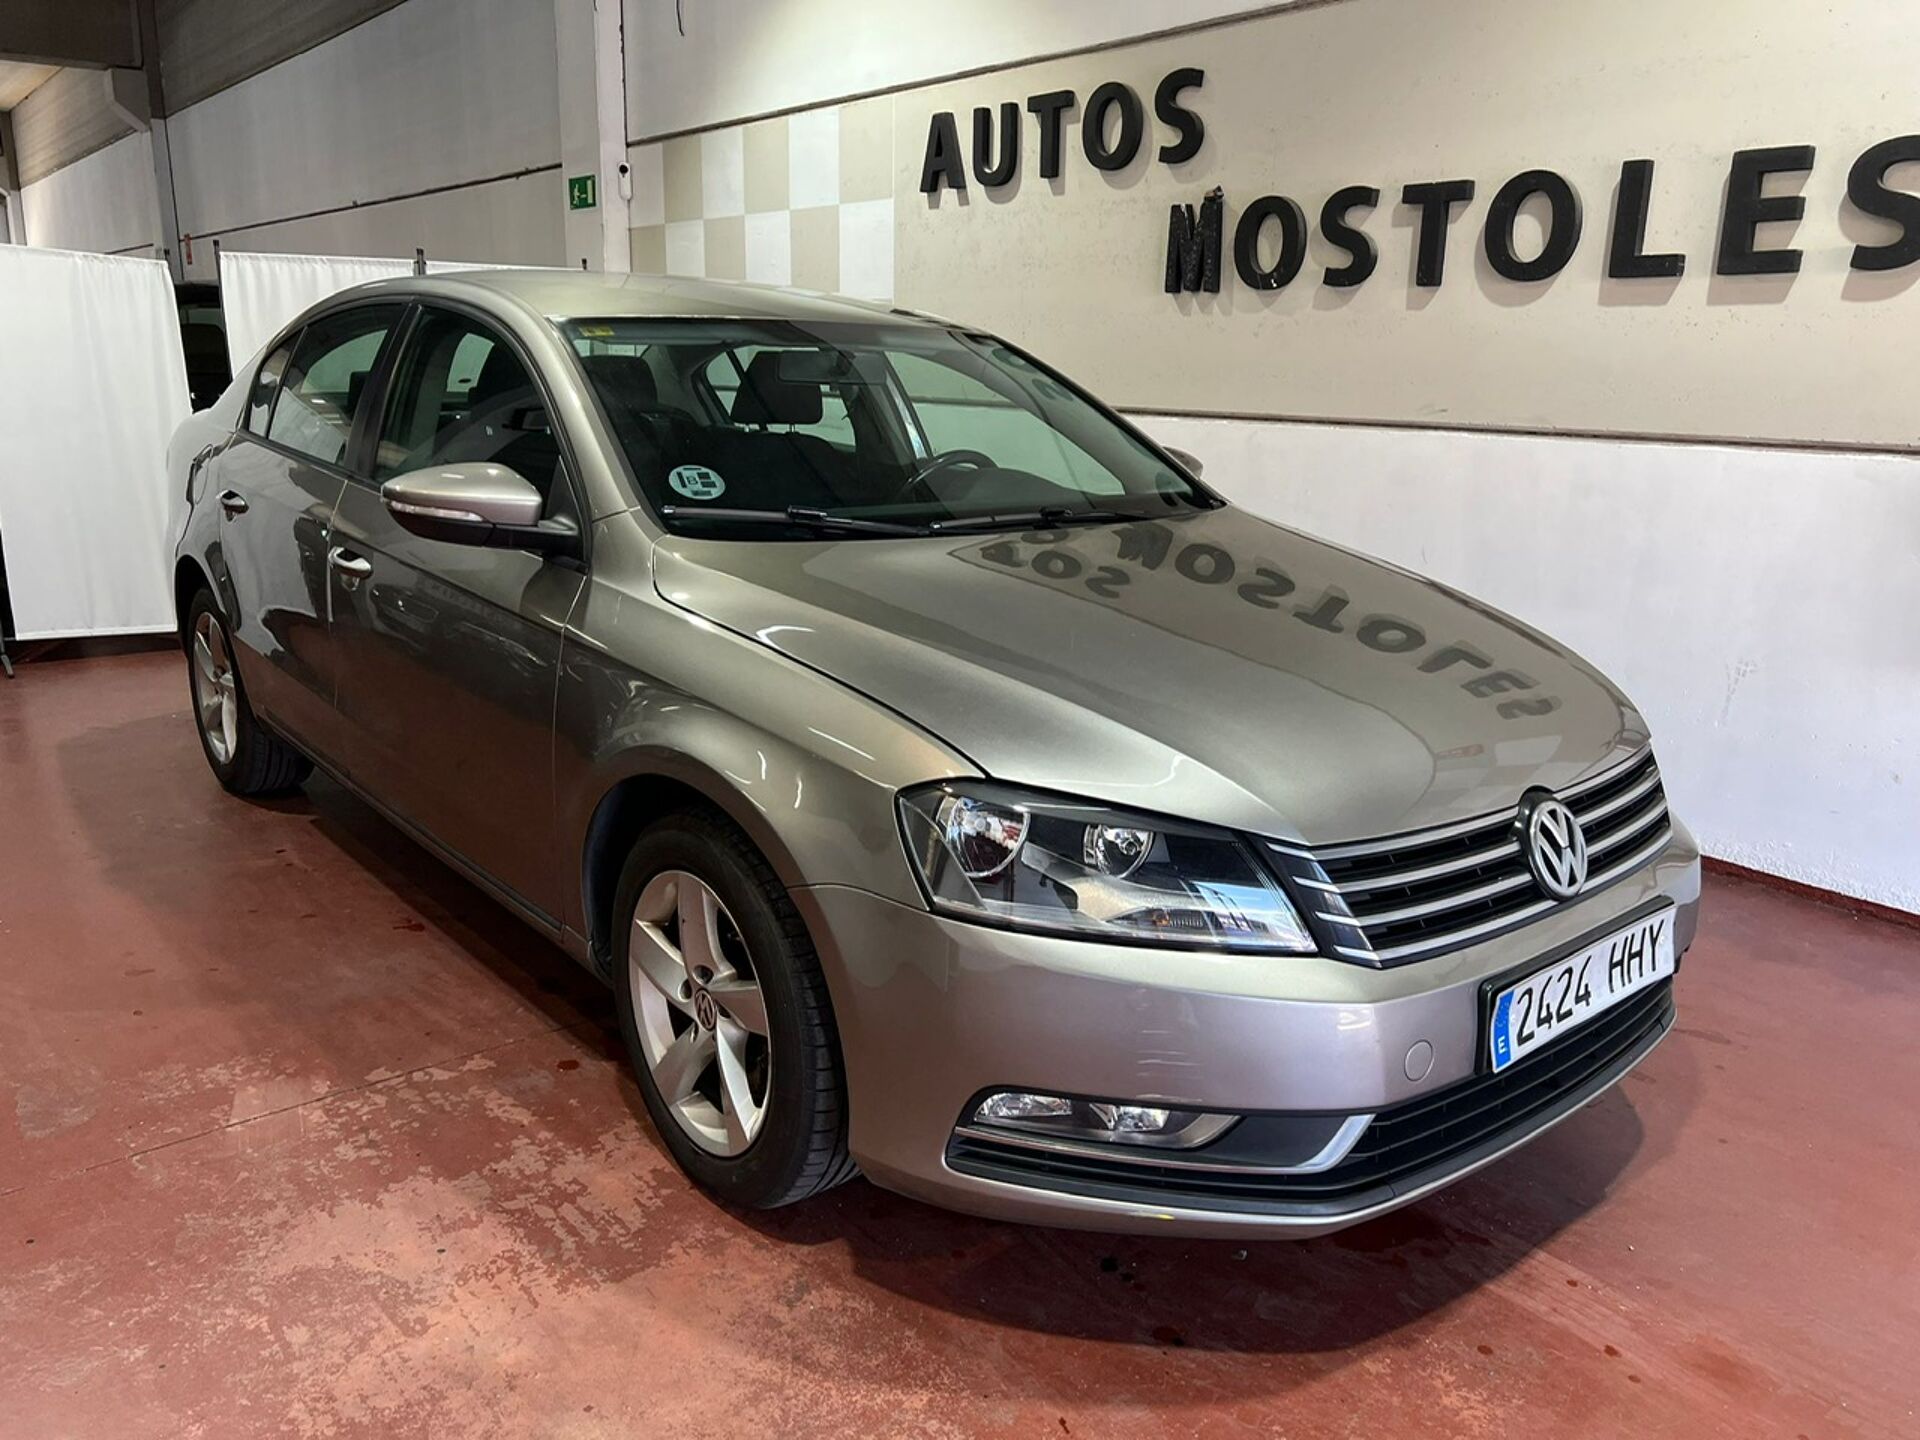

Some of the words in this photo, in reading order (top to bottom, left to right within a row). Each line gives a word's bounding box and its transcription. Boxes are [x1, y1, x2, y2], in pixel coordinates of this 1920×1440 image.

[920, 68, 1206, 194] AUTOS
[1165, 134, 1920, 294] MOSTOLES
[1516, 955, 1593, 1047] 2424
[1608, 919, 1665, 993] HHY
